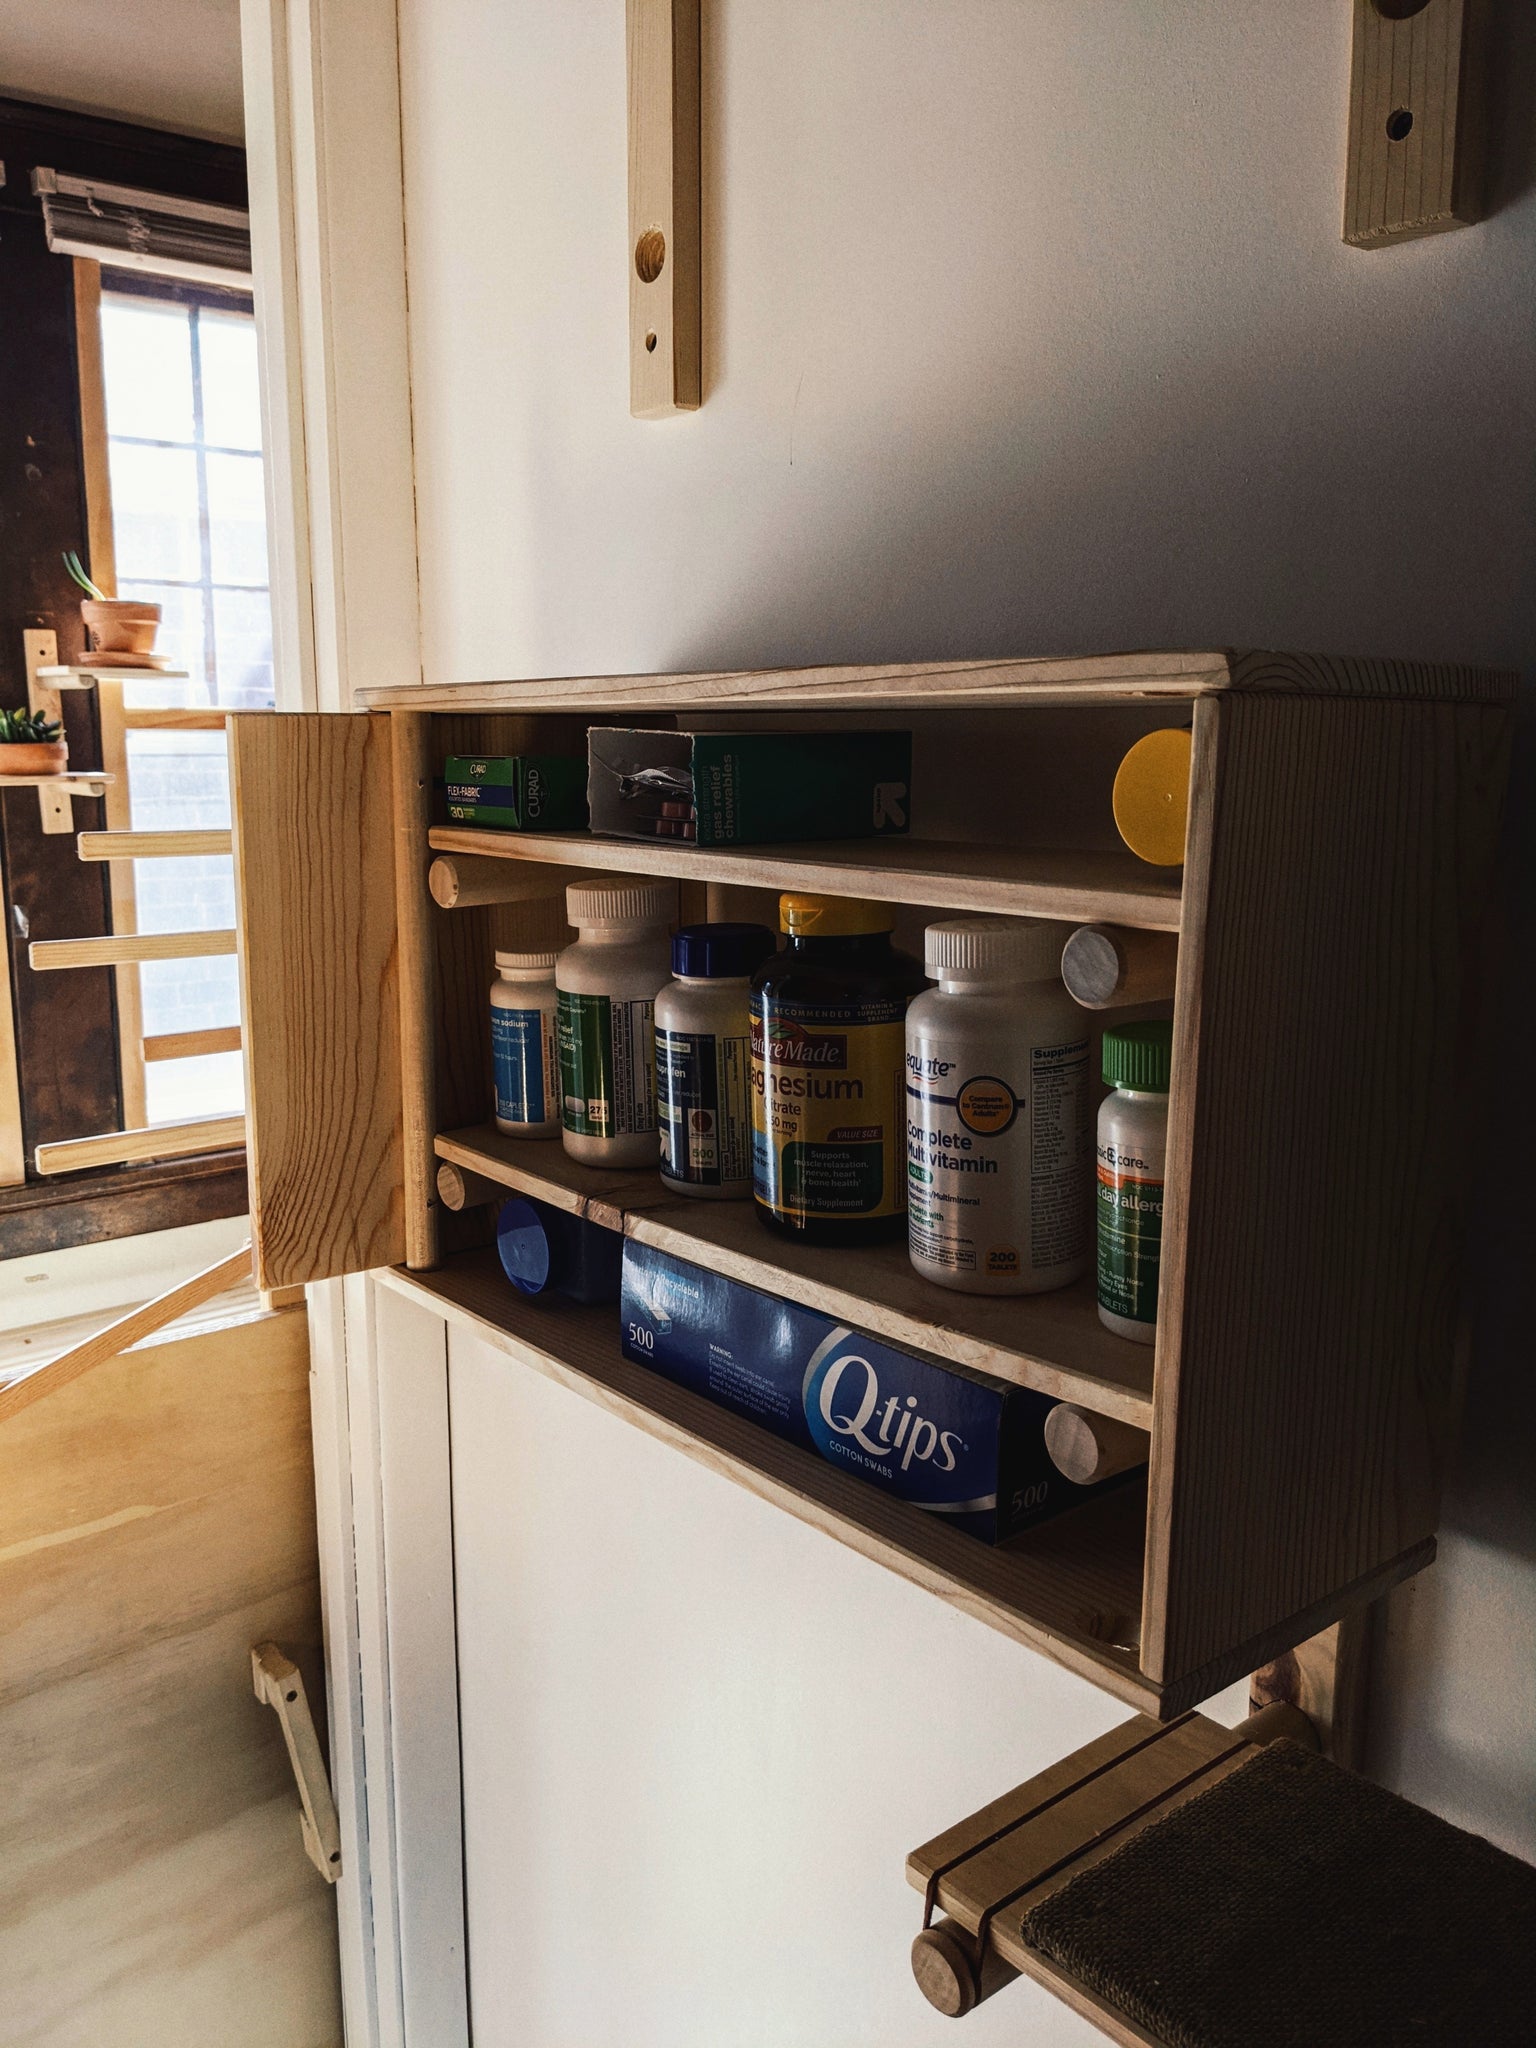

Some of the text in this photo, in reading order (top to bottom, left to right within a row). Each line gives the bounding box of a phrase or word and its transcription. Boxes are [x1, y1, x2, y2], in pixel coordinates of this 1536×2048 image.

[447, 786, 481, 797] FLEX-FABRIC
[528, 769, 540, 818] CURAD
[723, 753, 734, 839] chewables
[711, 766, 725, 840] gas relief
[450, 807, 464, 819] 30
[774, 1007, 852, 1018] RECOMMENDED
[501, 1019, 529, 1028] sodium
[783, 1040, 842, 1063] Made
[1032, 1040, 1090, 1059] Supplem
[969, 1095, 1003, 1103] Compare
[767, 1114, 798, 1133] 50 mg
[836, 1130, 881, 1139] VALUE SIZE
[908, 1119, 973, 1151] Complete
[692, 1148, 714, 1159] 500
[811, 1151, 851, 1161] Supports
[907, 1142, 999, 1174] Multvitamin
[794, 1160, 822, 1168] muscle
[1117, 1154, 1144, 1169] care
[806, 1168, 857, 1178] nerve, heart
[808, 1179, 829, 1187] bone
[790, 1194, 864, 1209] Dietary Supplement
[1101, 1186, 1118, 1208] day
[929, 1210, 944, 1222] with
[989, 1252, 1017, 1263] 200
[628, 1321, 655, 1351] 500
[709, 1342, 734, 1359] WARNING:
[819, 1354, 964, 1473] Q-tips
[829, 1440, 893, 1480] COTTON SWABS
[1010, 1480, 1049, 1515] 500
